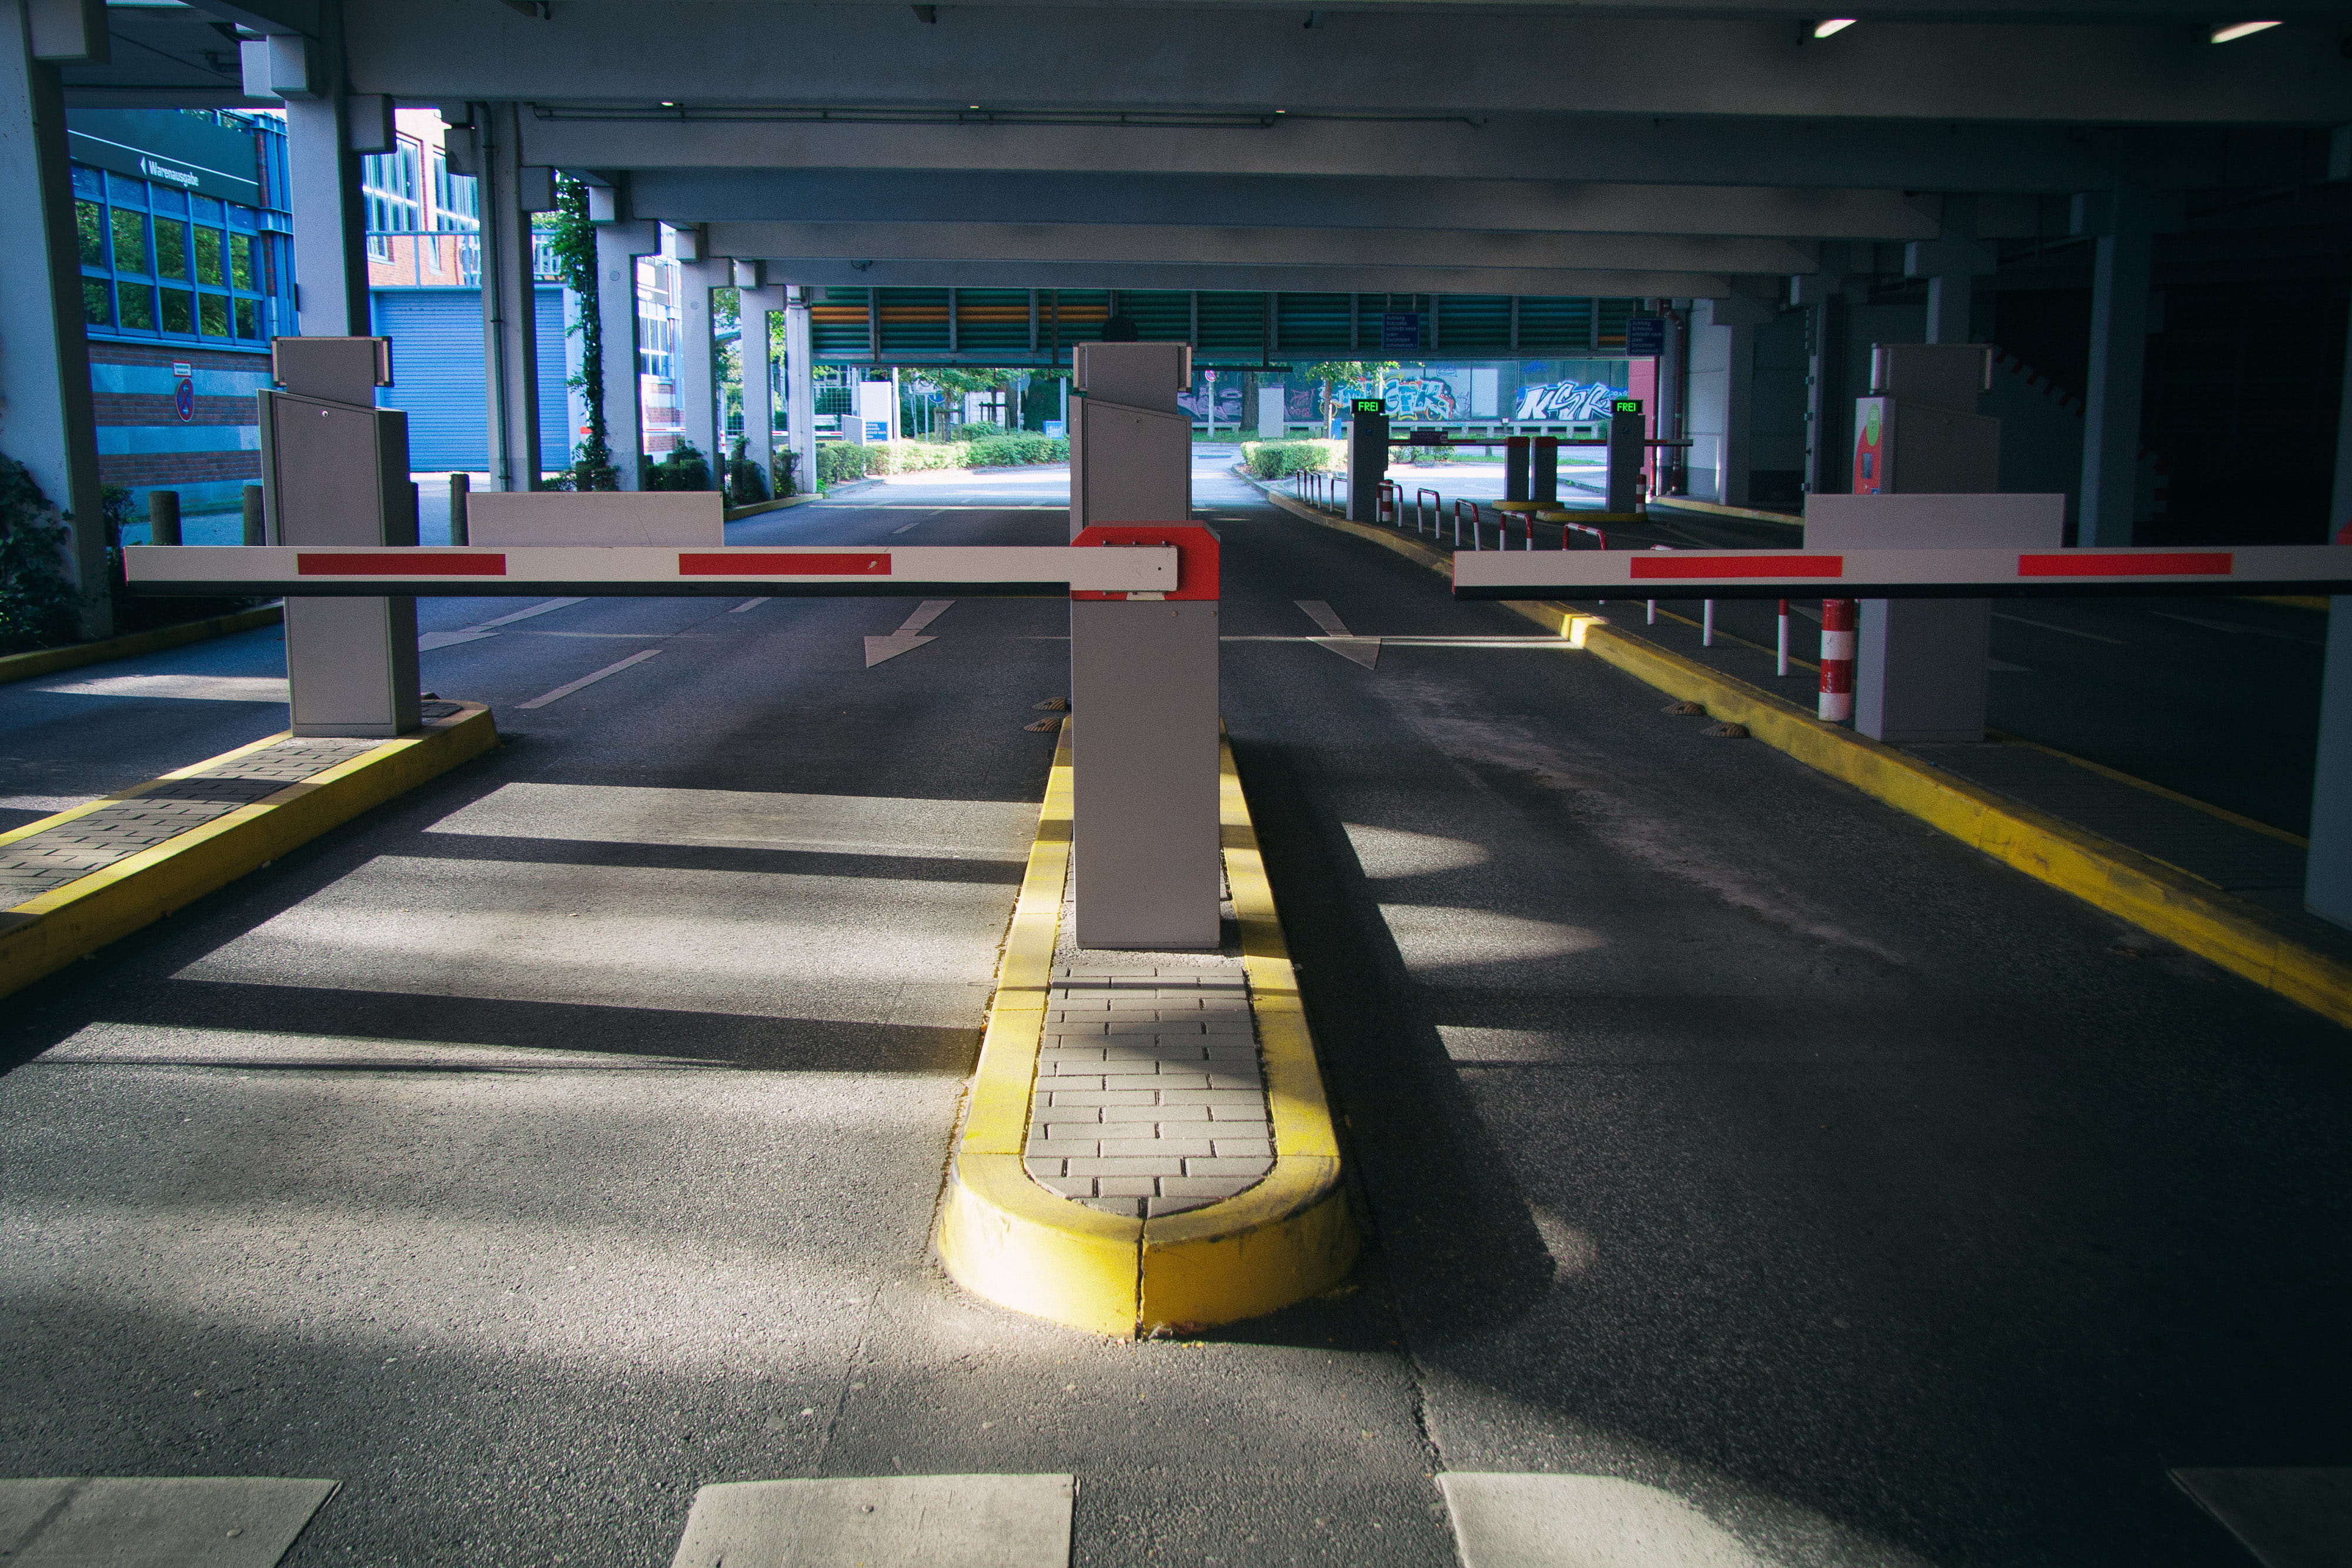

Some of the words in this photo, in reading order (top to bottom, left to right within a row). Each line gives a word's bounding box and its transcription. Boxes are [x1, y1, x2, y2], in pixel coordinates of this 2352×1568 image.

[148, 160, 199, 187] Warenausgabe
[1358, 402, 1378, 412] FREI
[1617, 402, 1636, 412] FREI
